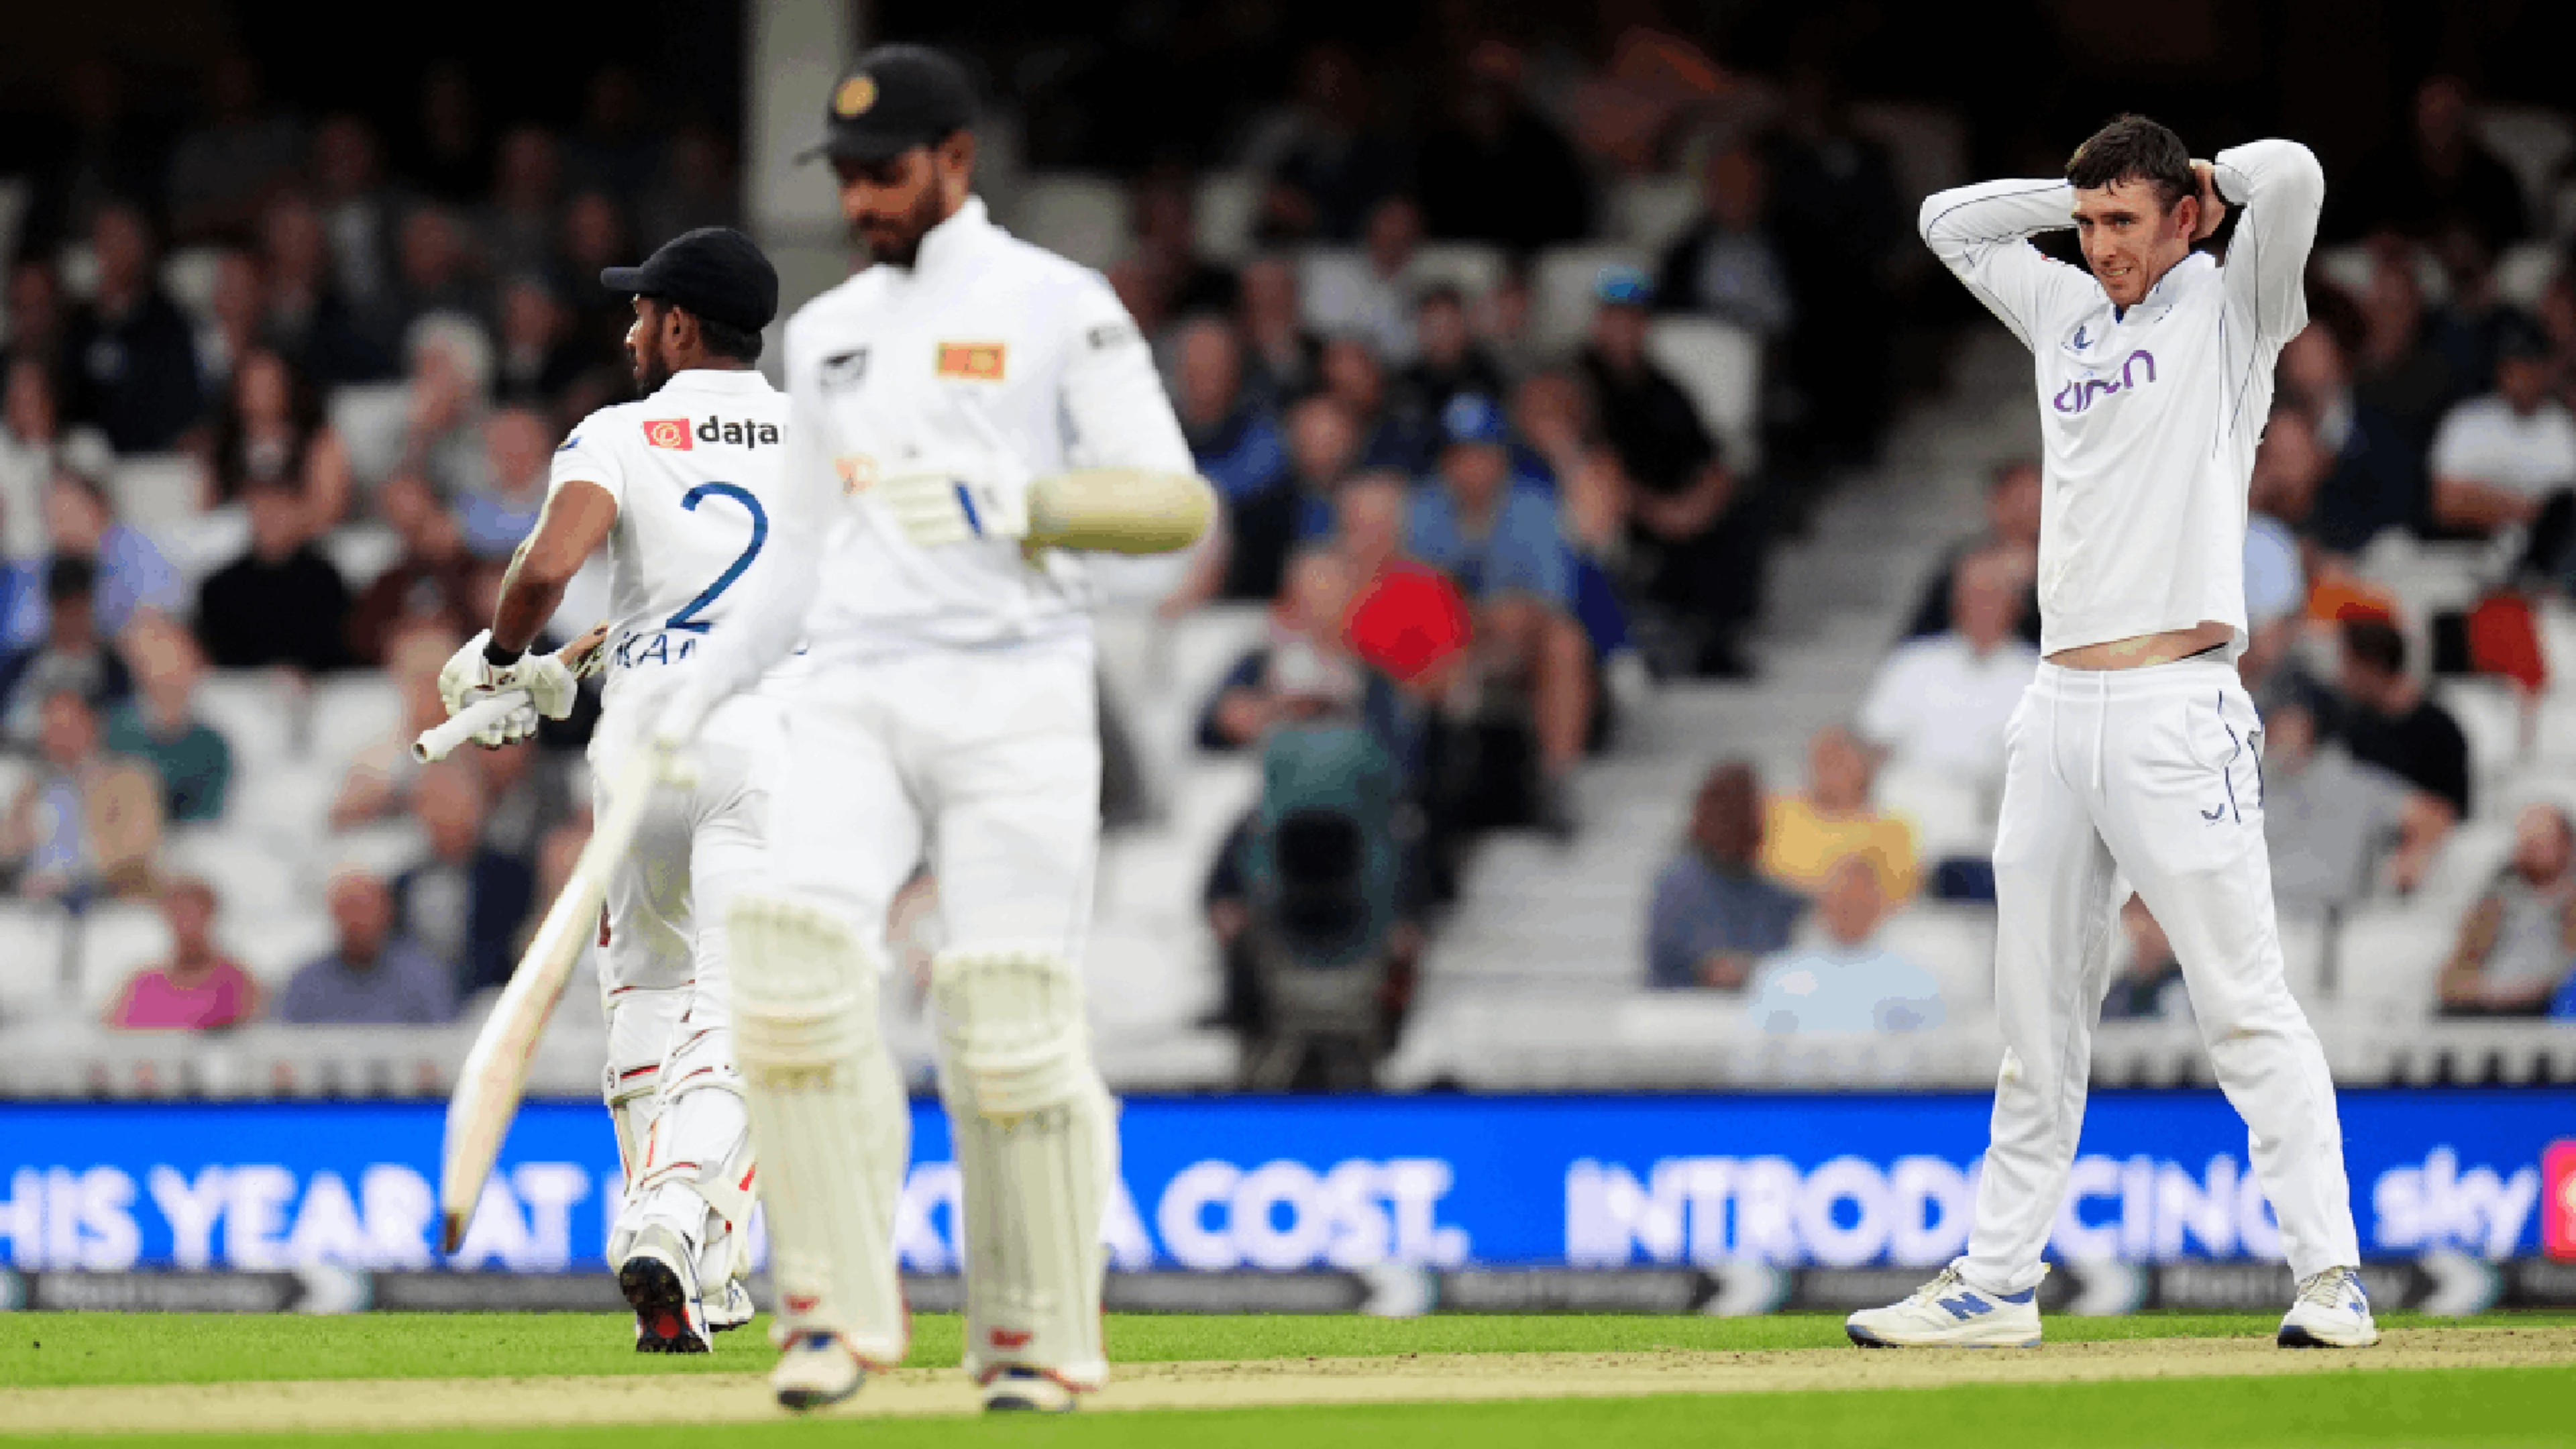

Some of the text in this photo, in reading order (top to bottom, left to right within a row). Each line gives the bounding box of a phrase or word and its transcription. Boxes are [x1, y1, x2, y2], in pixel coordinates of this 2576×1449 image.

[696, 415, 786, 451] data
[665, 482, 769, 633] 2
[149, 1164, 436, 1269] YEAR
[446, 1163, 589, 1269] AT
[1157, 1159, 1469, 1268] COST.
